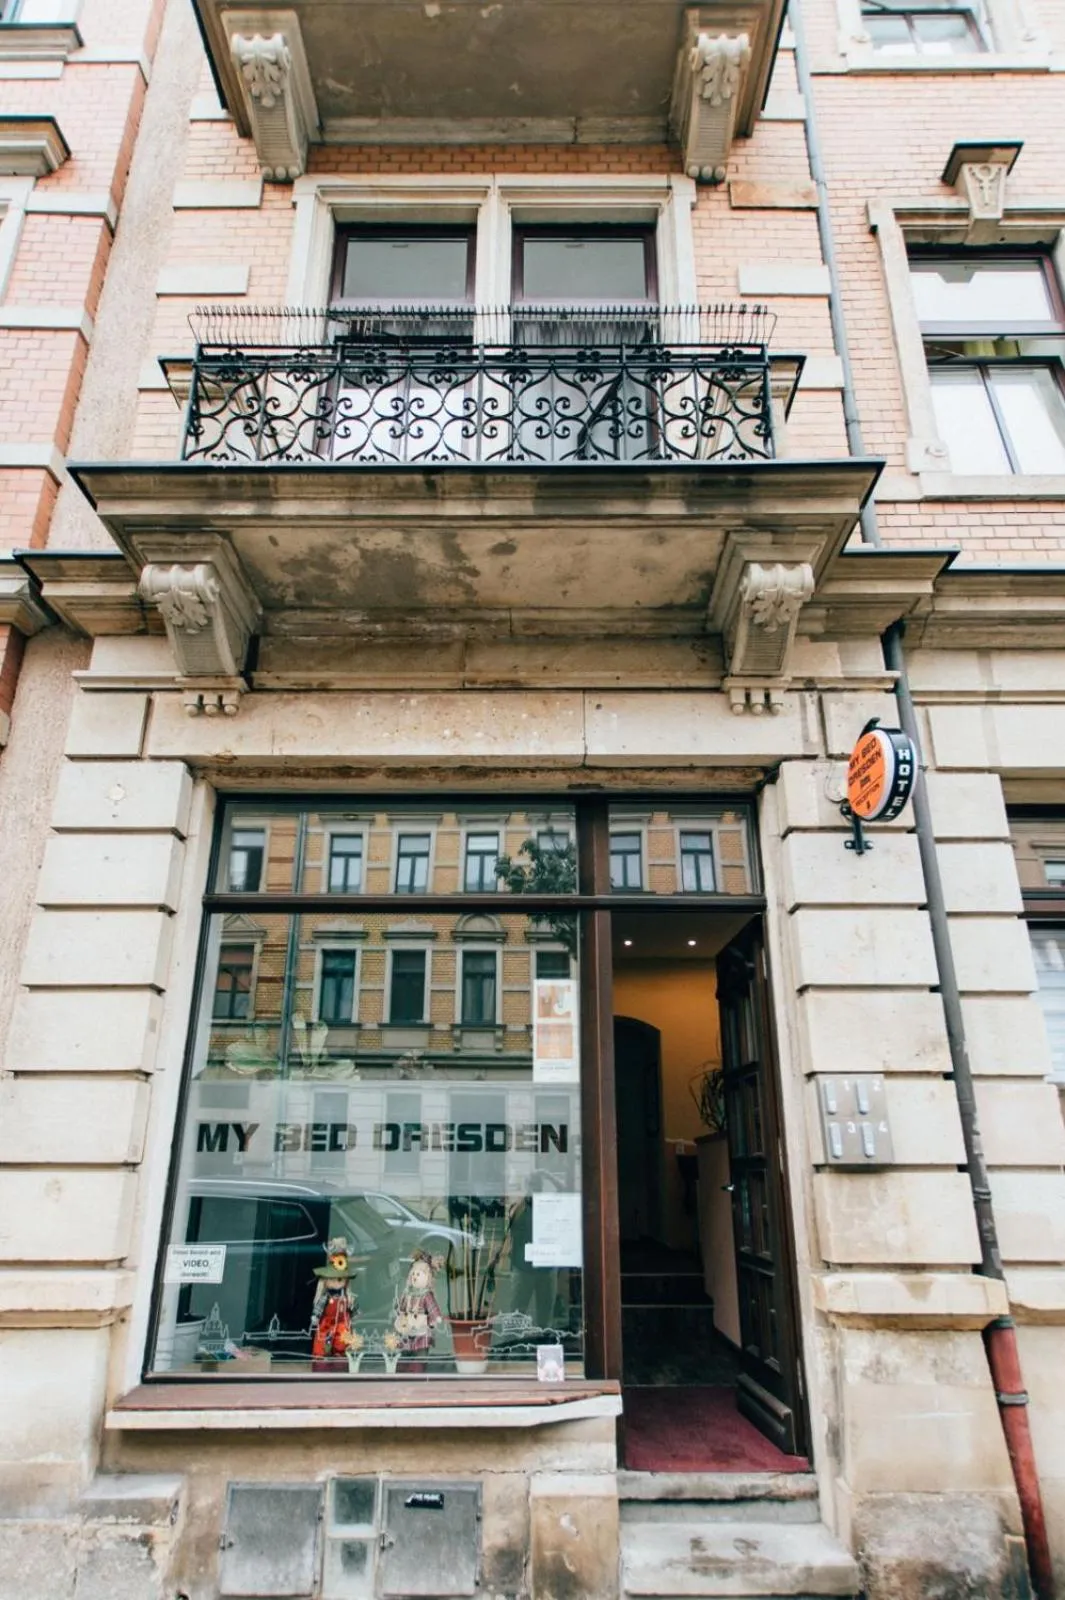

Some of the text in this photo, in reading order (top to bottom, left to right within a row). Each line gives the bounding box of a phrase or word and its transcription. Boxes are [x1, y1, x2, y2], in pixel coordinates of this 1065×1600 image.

[885, 749, 911, 816] HOTEL
[872, 1080, 881, 1091] 2
[847, 1121, 856, 1133] 3
[196, 1123, 568, 1153] MY BED DRESDEN
[182, 1259, 209, 1268] VIDEO
